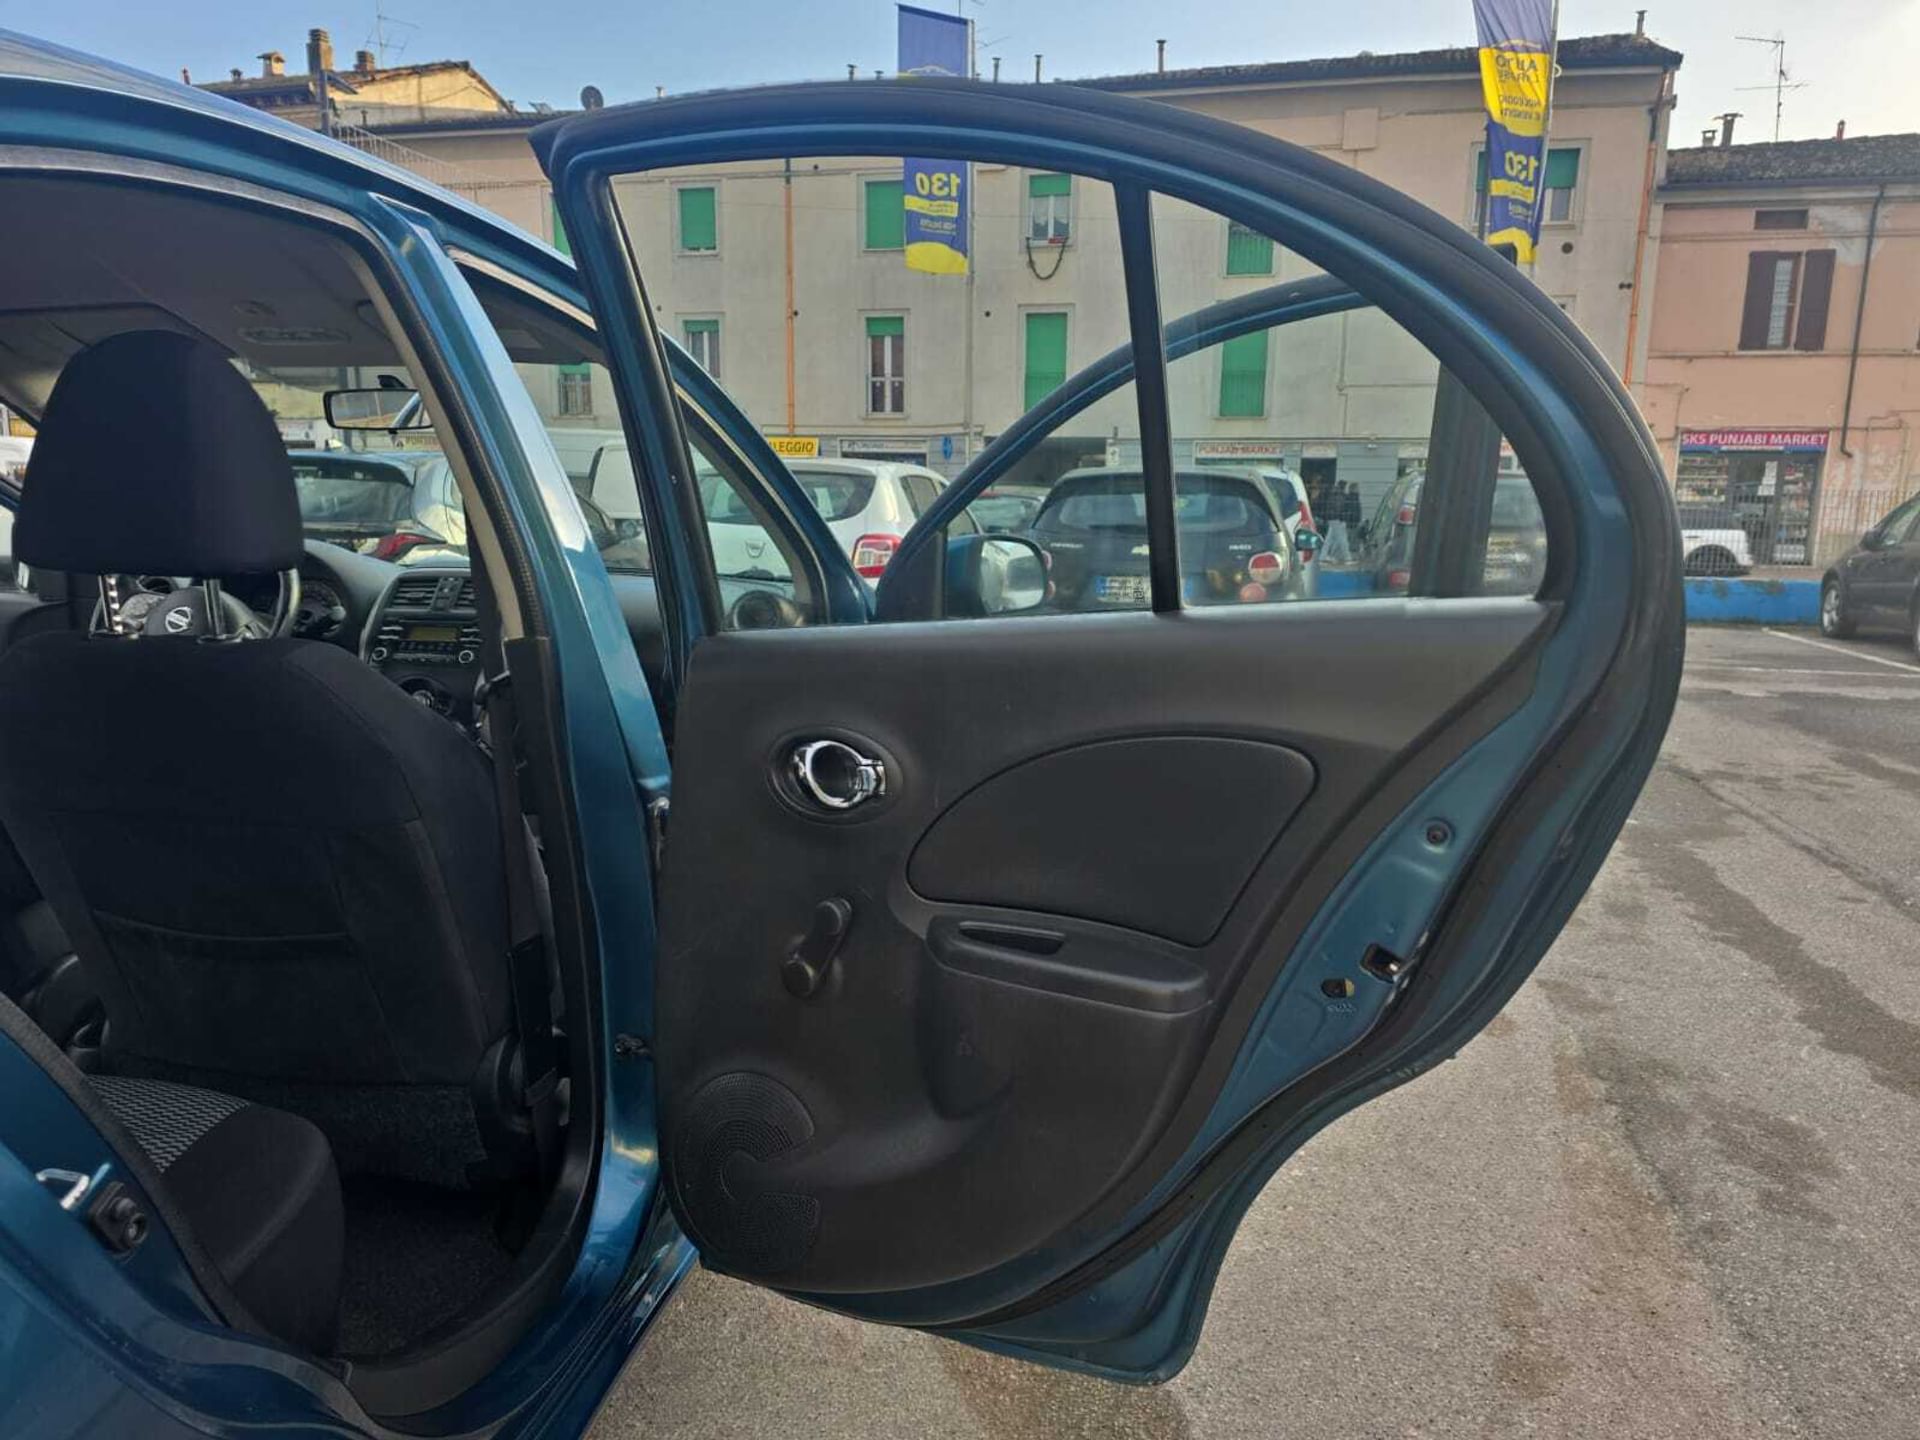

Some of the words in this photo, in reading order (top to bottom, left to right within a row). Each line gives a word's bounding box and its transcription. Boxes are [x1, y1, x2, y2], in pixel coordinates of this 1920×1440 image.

[1682, 432, 1708, 445] SKS
[1709, 432, 1766, 445] PUNJABI
[1770, 433, 1826, 445] MARKET
[768, 441, 815, 453] LEGGIO
